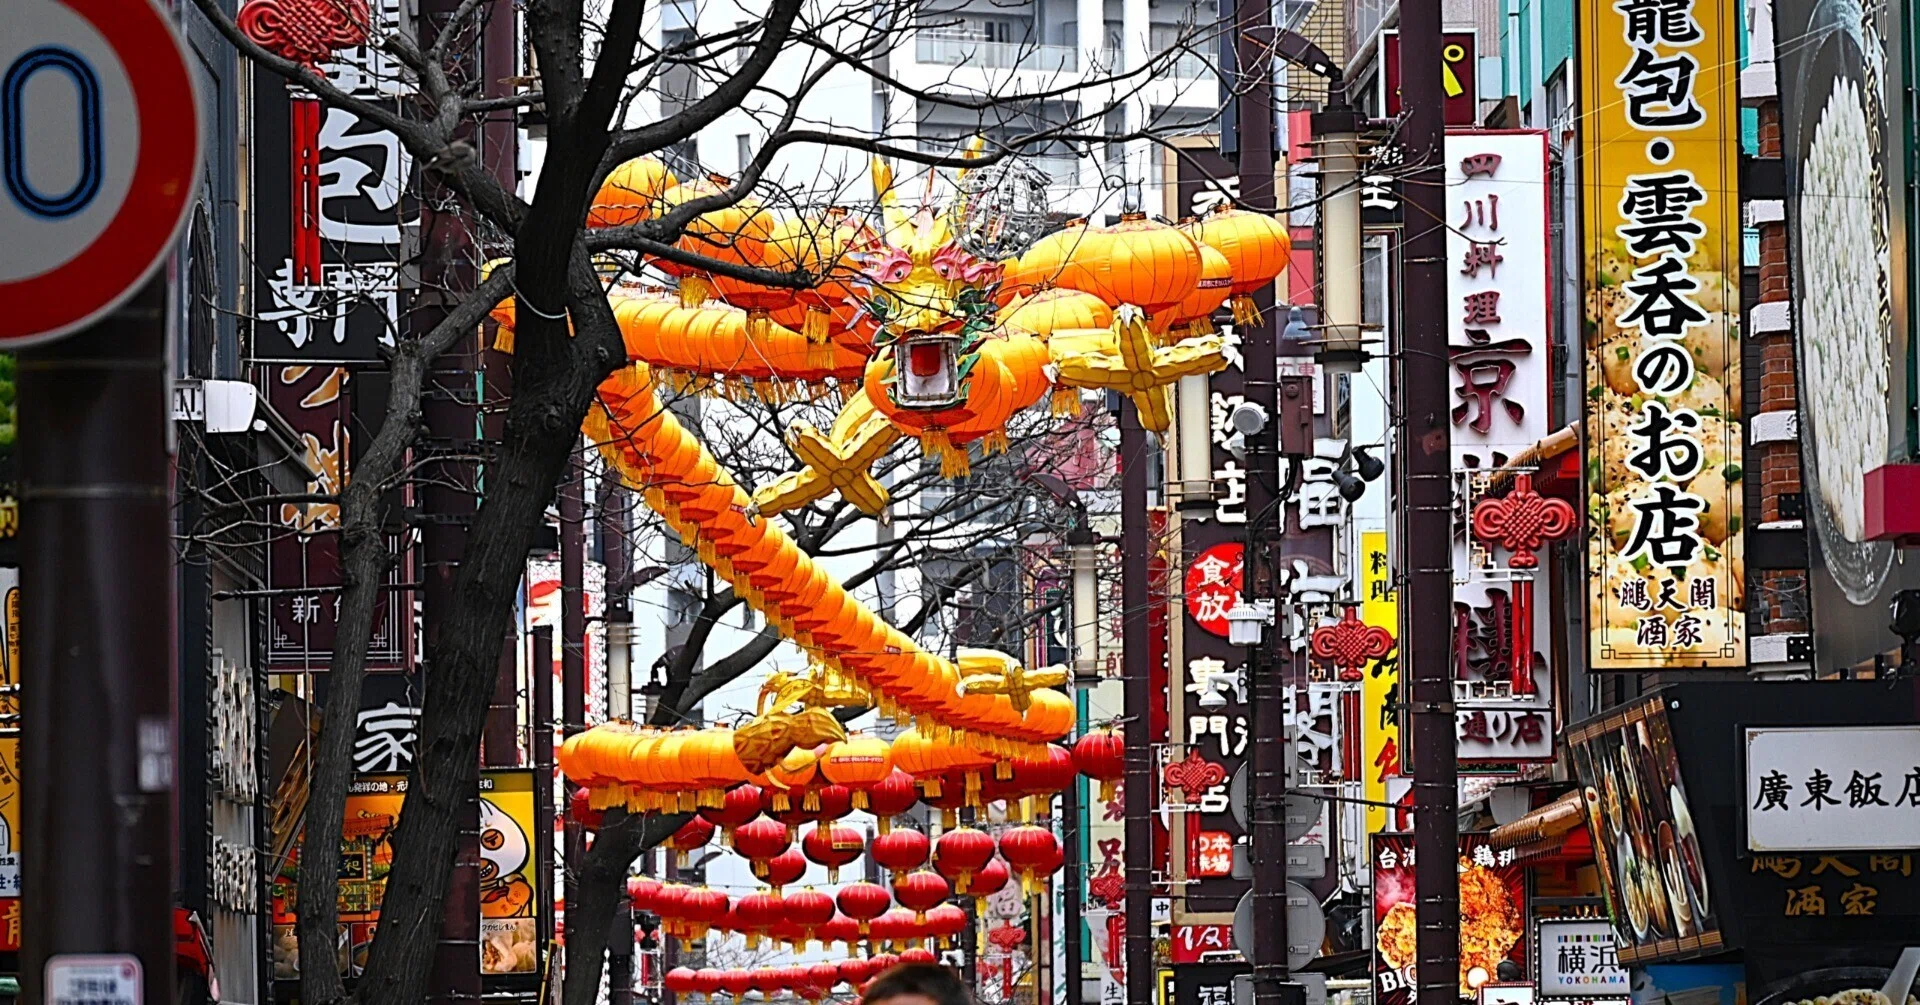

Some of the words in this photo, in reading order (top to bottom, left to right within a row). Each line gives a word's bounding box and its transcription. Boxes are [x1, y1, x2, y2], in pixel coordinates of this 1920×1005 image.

[1460, 153, 1503, 324] 四川料理
[1636, 615, 1703, 647] 酒家
[353, 702, 422, 772] 家
[1455, 710, 1546, 745] 通り店
[1558, 945, 1628, 974] 横浜
[1558, 975, 1625, 985] YOKOHAMA
